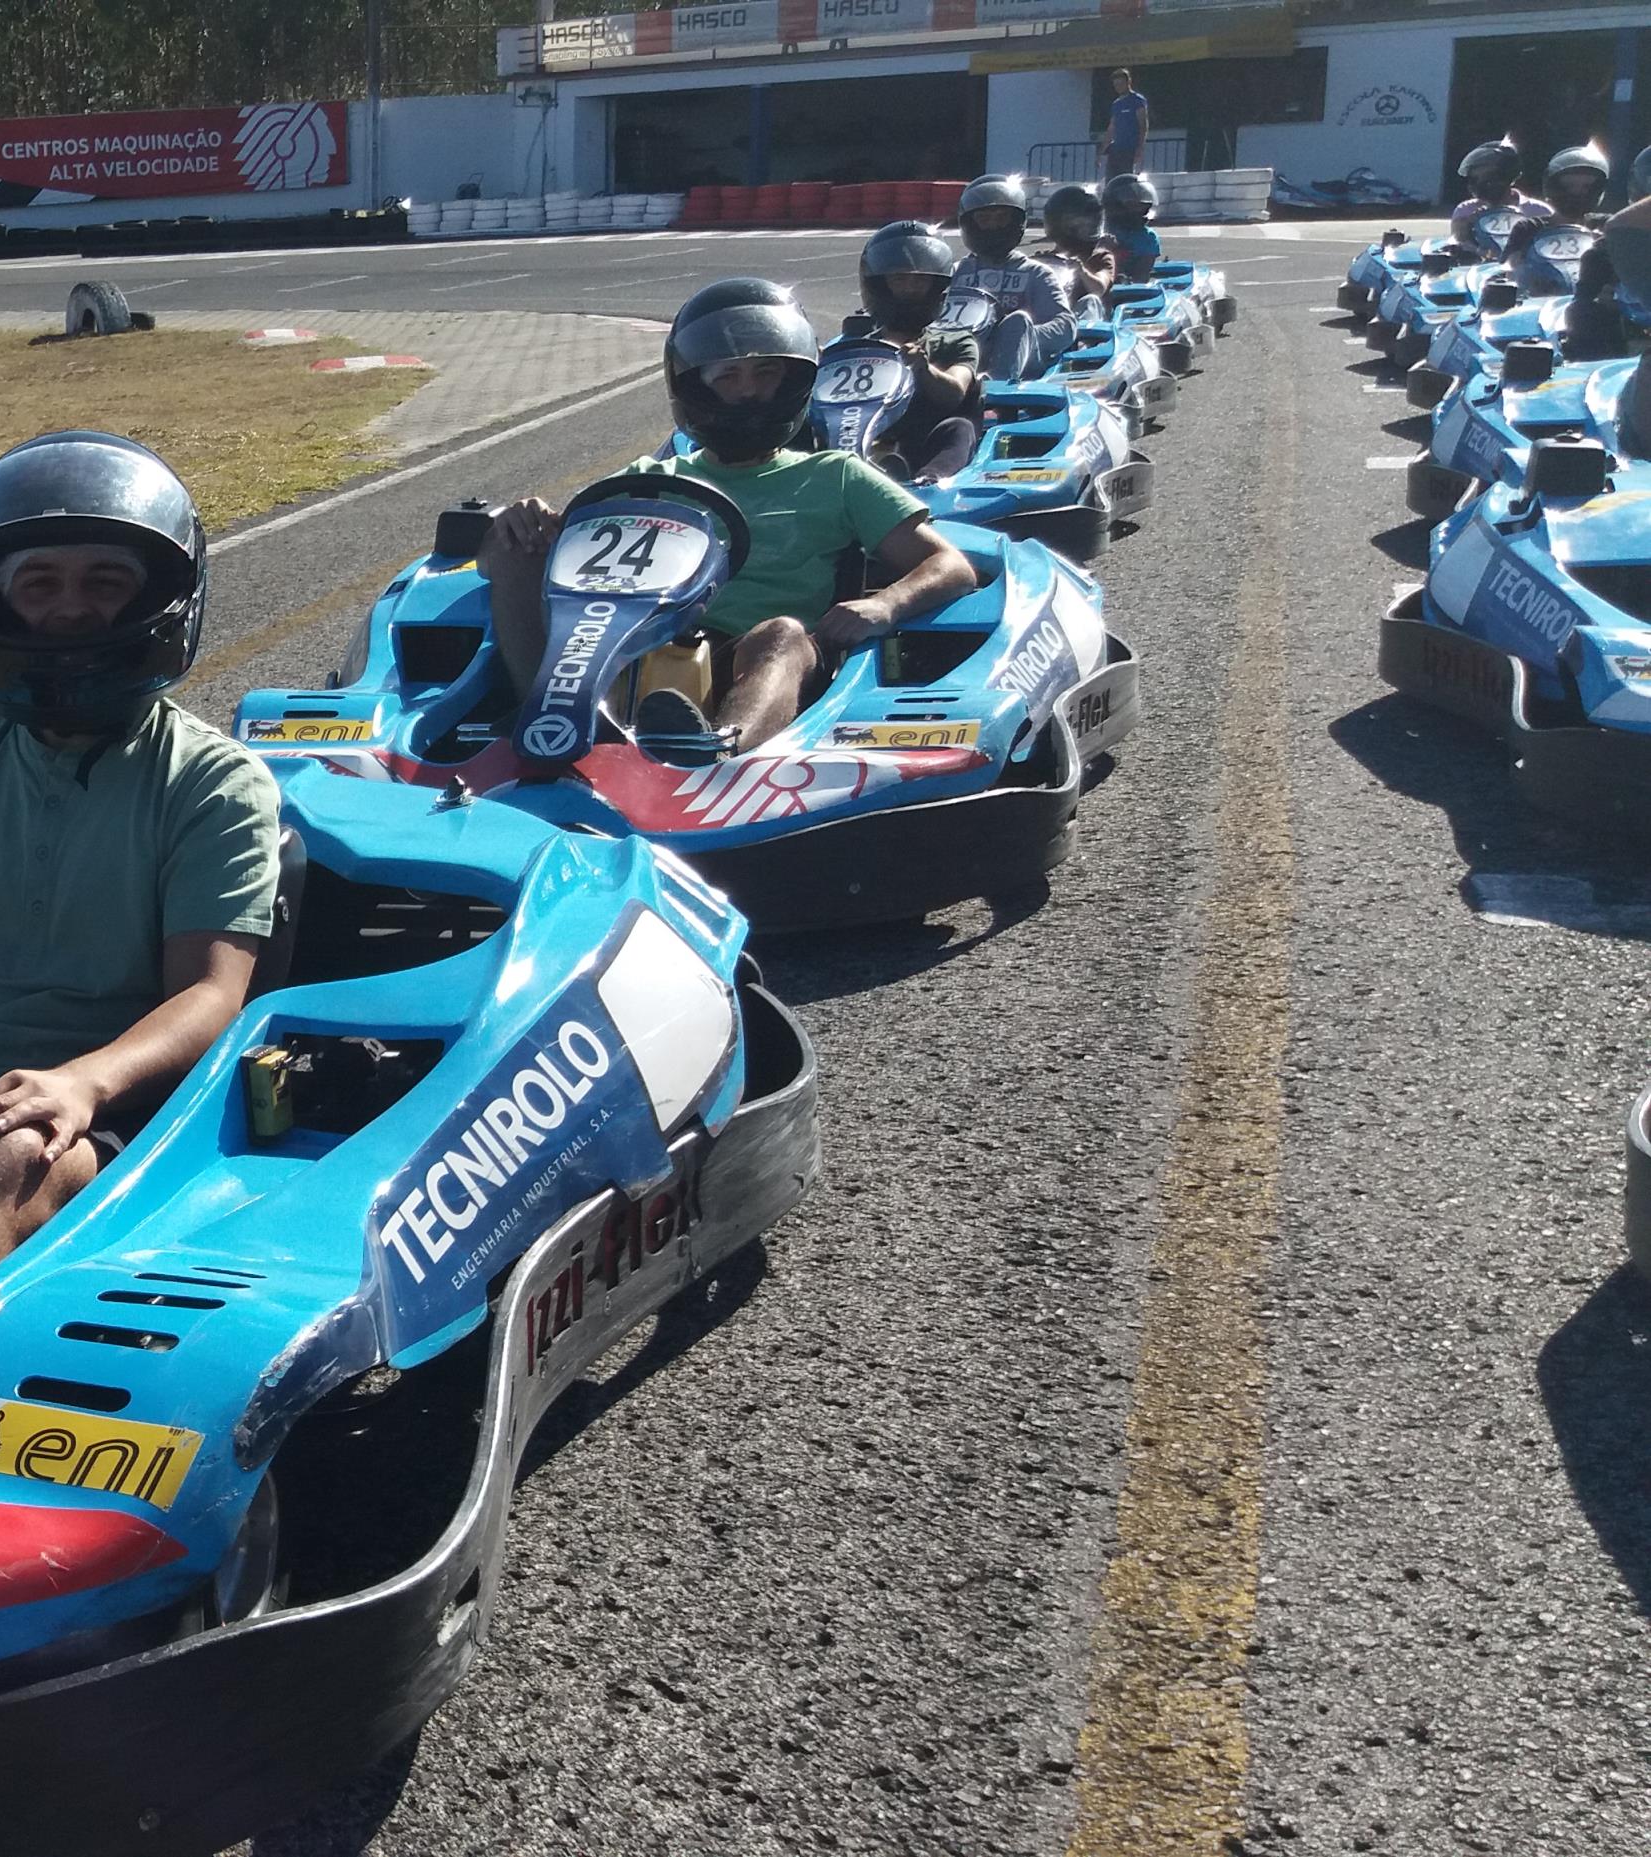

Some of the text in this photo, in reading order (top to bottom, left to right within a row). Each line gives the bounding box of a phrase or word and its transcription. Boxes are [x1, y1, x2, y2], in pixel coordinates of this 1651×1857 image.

[543, 22, 606, 44] HASCO
[678, 9, 747, 31] HASCO
[1, 128, 222, 159] CENTROS MAQUINAÇÃO
[49, 156, 219, 181] ALTA VELOCIDADE
[1549, 240, 1580, 255] 23
[830, 364, 874, 396] 28
[575, 523, 661, 577] 24
[1489, 559, 1578, 653] TECNIRO
[541, 601, 617, 711] TECNIROLO
[997, 620, 1064, 699] CNIROLO
[294, 720, 366, 742] eni
[888, 723, 969, 747] eni
[379, 1020, 611, 1284] TECNIROLO
[451, 1108, 614, 1291] ENGENHARIA INDUSTRIAL, S.A.
[14, 1427, 185, 1501] eni
